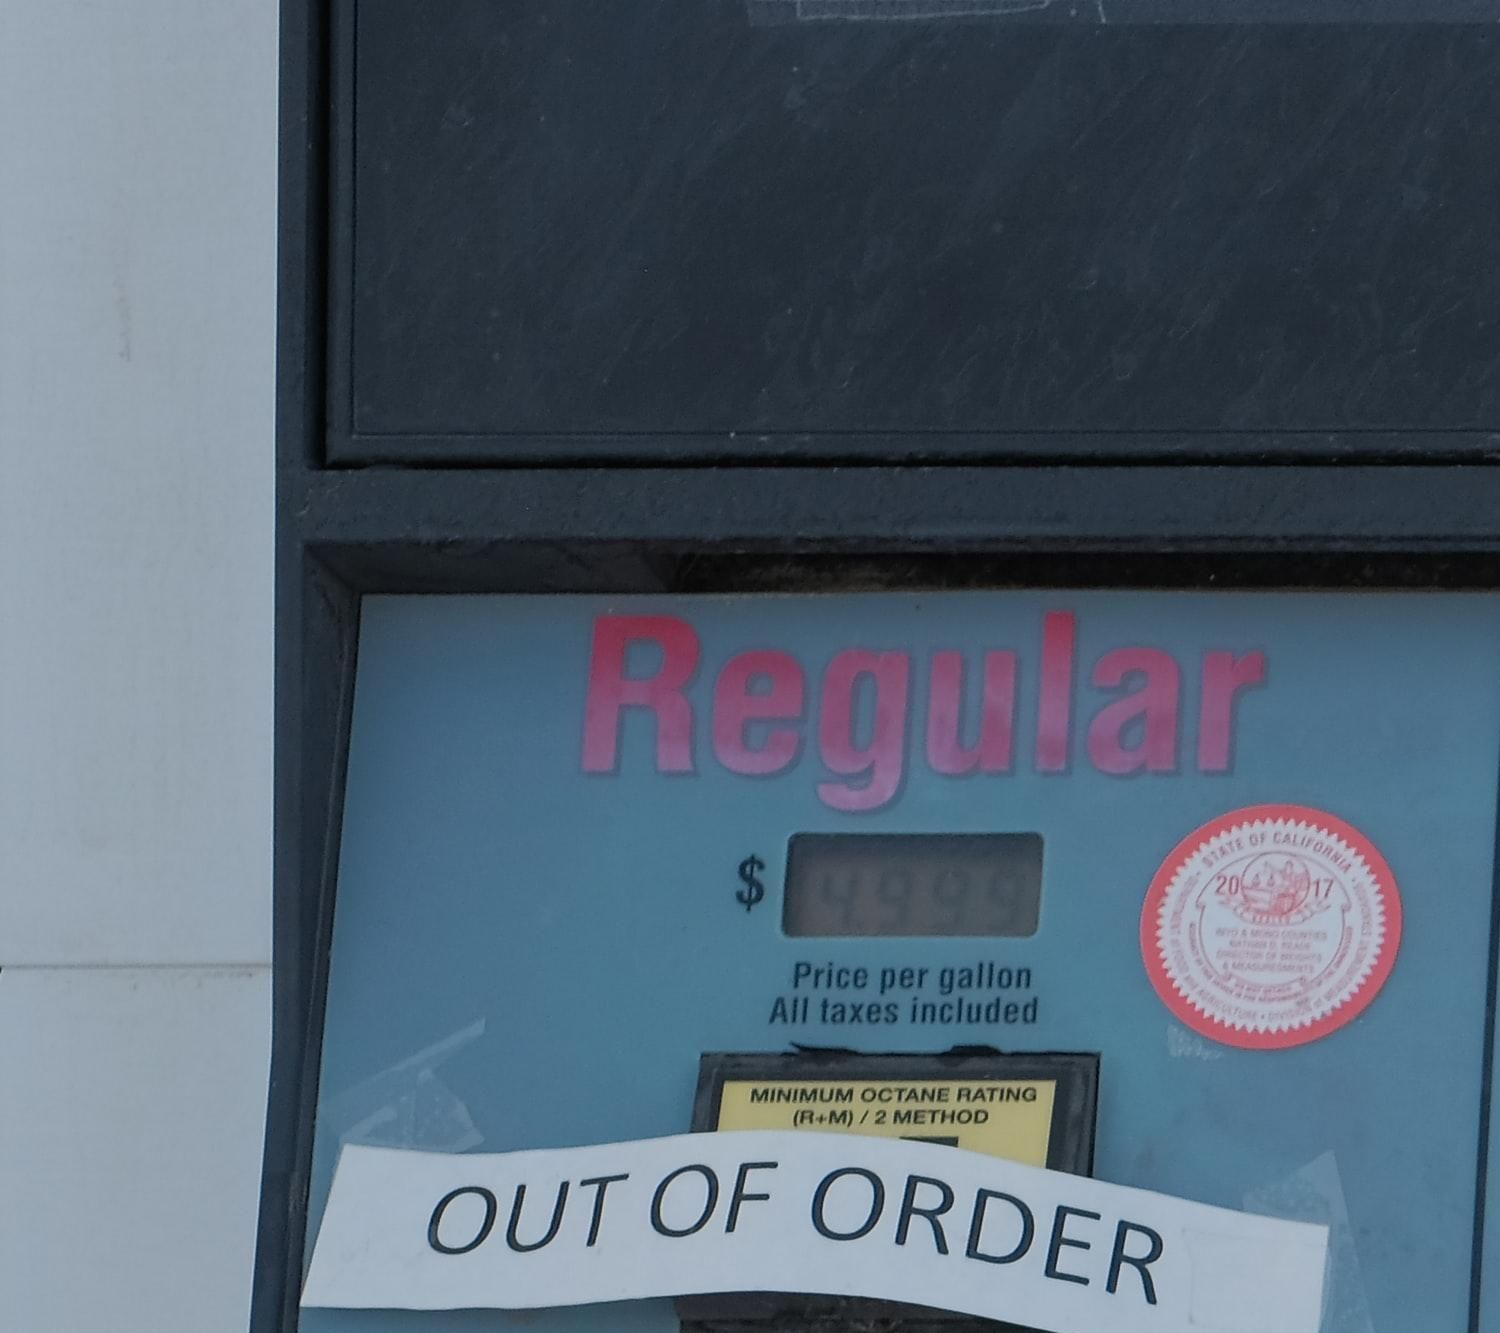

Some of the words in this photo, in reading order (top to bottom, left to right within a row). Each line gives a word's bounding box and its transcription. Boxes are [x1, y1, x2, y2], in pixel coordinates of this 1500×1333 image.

[580, 611, 1268, 814] Regular
[736, 854, 765, 910] $
[793, 963, 872, 990] Price
[880, 968, 929, 997] per
[938, 963, 1031, 998] gallon
[769, 998, 809, 1025] All
[819, 999, 899, 1025] taxes
[910, 998, 1038, 1025] included
[750, 1086, 853, 1103] MINIMUM
[859, 1086, 949, 1103] OCTANE
[955, 1086, 1038, 1103] RATING
[792, 1109, 855, 1128] (R+M)
[873, 1109, 888, 1125] 2
[893, 1109, 989, 1125] METHOD
[426, 1173, 630, 1255] OUT
[649, 1161, 779, 1239] OF
[810, 1166, 1164, 1306] ORDER
